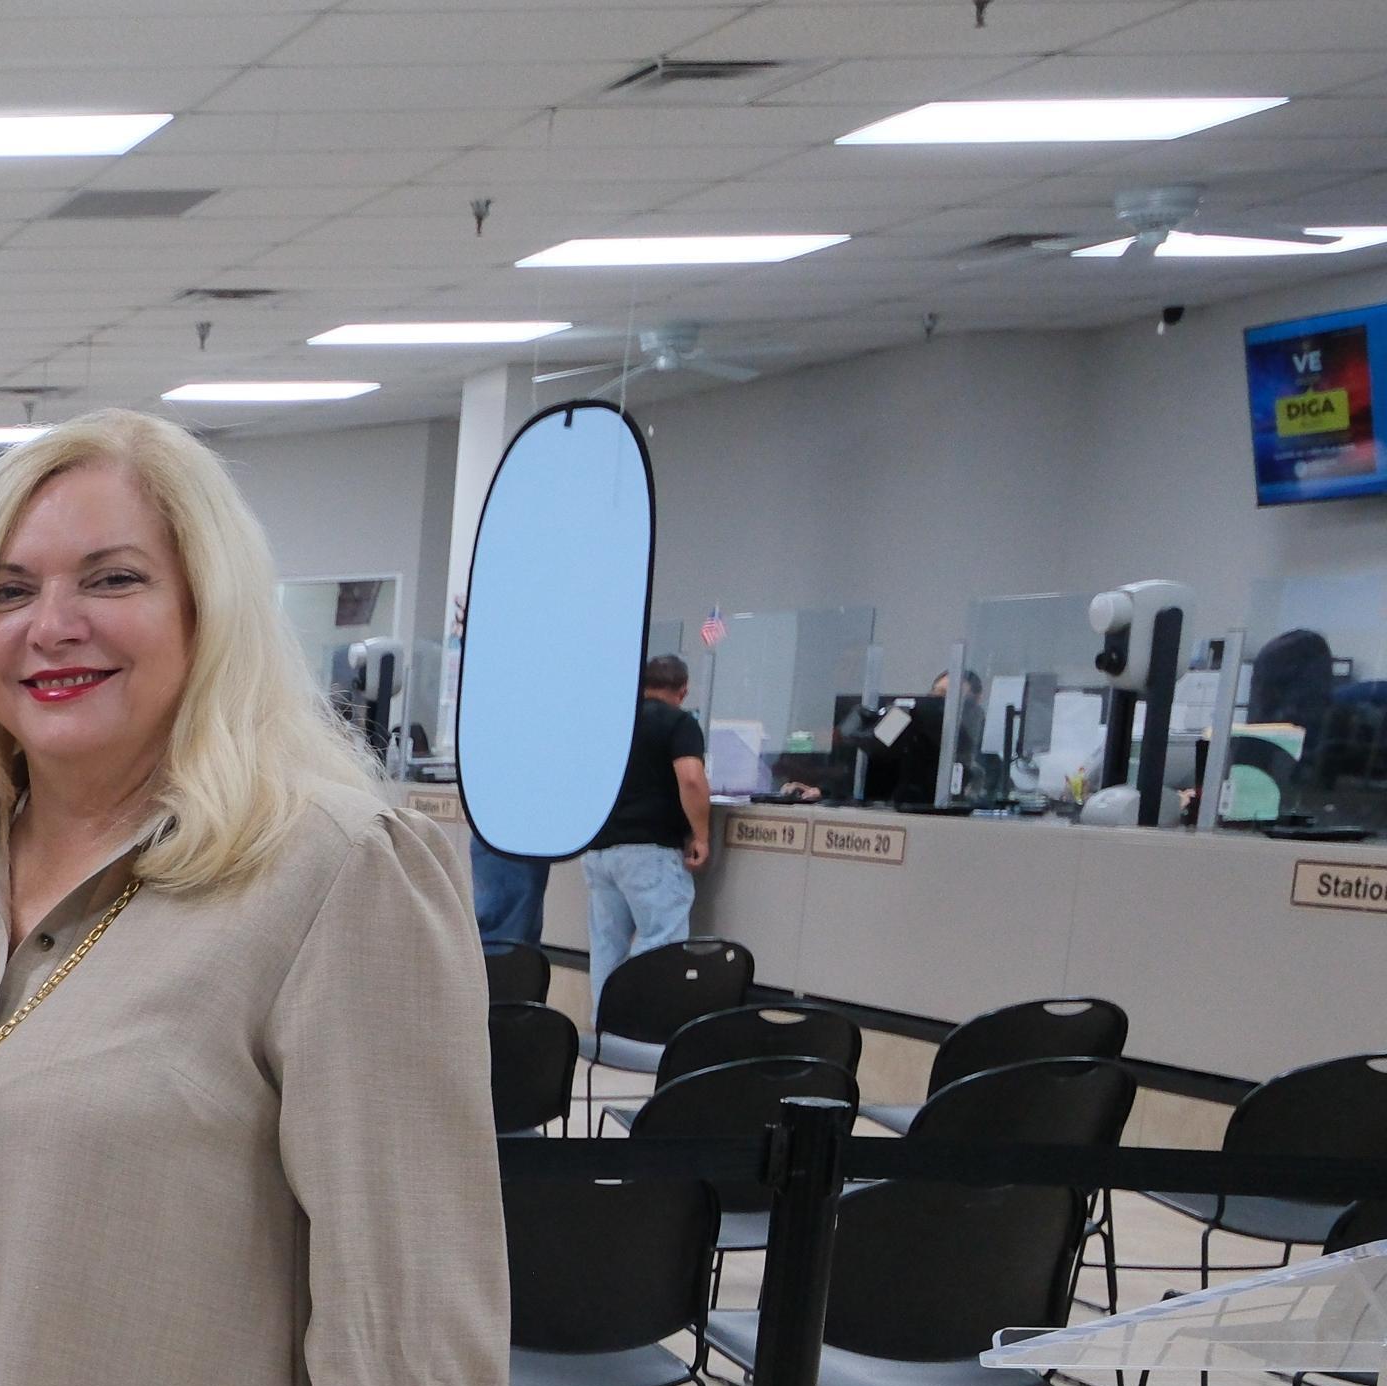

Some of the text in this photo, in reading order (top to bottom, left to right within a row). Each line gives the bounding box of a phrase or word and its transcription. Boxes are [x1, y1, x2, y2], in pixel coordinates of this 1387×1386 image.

[1292, 350, 1323, 373] VE
[736, 822, 795, 845] Station 19
[826, 829, 890, 854] Station 20
[1317, 873, 1387, 901] Statio
